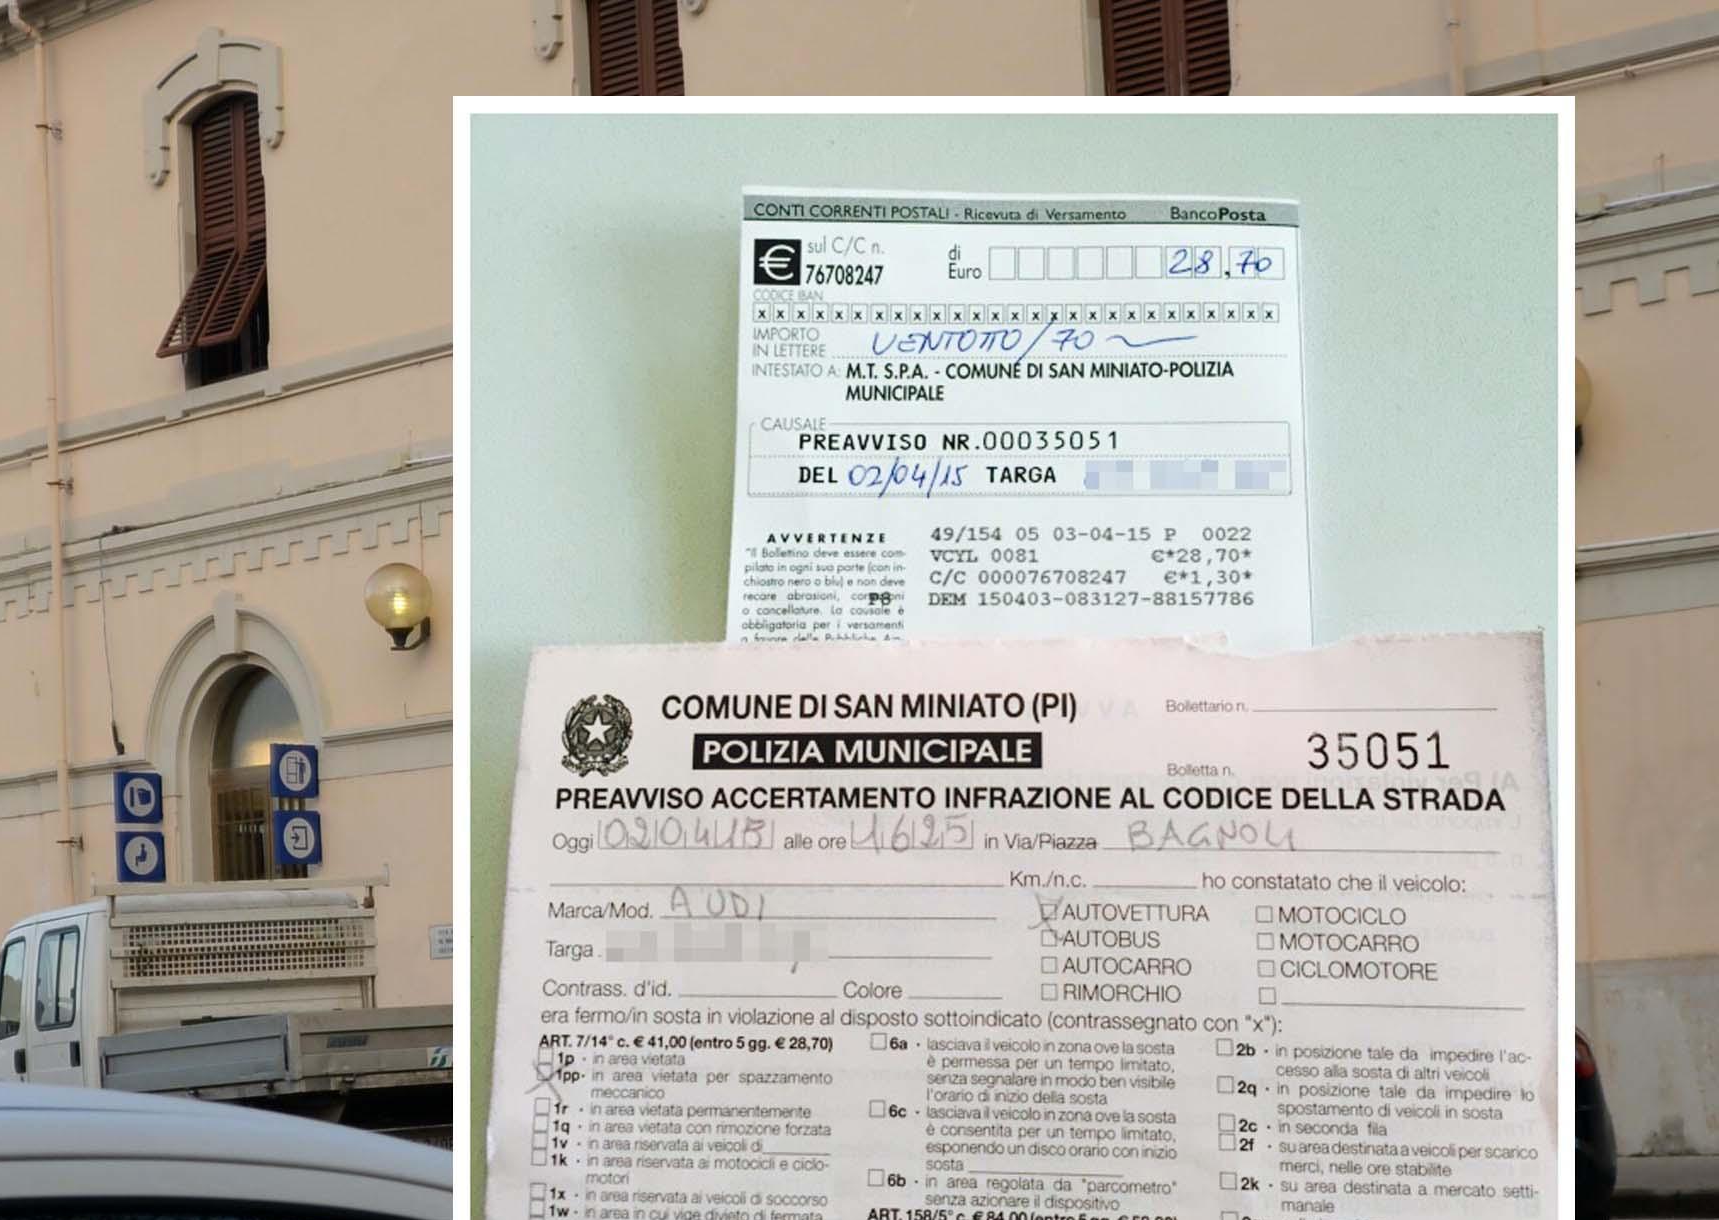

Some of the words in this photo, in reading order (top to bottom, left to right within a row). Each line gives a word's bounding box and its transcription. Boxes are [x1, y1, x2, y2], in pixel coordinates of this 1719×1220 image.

[754, 204, 804, 217] CONTI
[810, 204, 886, 218] CORRENTI
[892, 206, 949, 219] POSTALI
[964, 208, 1022, 220] Ricevuta
[1026, 209, 1038, 220] di
[1047, 208, 1127, 221] Versamento
[1170, 207, 1266, 222] BancoPosta
[808, 235, 826, 254] sul
[832, 236, 865, 256] C/C
[871, 242, 884, 254] n.
[948, 244, 960, 260] di
[806, 264, 883, 285] 76708247
[949, 263, 982, 279] Euro
[753, 290, 794, 300] CODICE
[798, 290, 823, 300] IBAN
[753, 327, 824, 341] IMPORTO
[753, 343, 767, 356] IN
[774, 343, 826, 358] LETTERE
[752, 363, 823, 378] INTESTATO
[846, 363, 877, 379] M.T.
[884, 363, 928, 379] S.P.A.
[946, 362, 1021, 378] COMUNE
[1027, 363, 1042, 378] DI
[1049, 363, 1084, 378] SAN
[1090, 361, 1234, 378] MINIATO-POLIZIA
[846, 385, 944, 401] MUNICIPALE
[761, 418, 826, 431] CAUSALE
[800, 434, 926, 450] PREAVVISO
[943, 431, 1116, 450] NR.00035051
[799, 467, 838, 483] DEL
[986, 467, 1056, 483] TARGA
[767, 533, 884, 543] AVVERTENZE
[931, 527, 1001, 543] 49/154
[1016, 527, 1039, 541] 05
[1053, 527, 1151, 541] 03-04-15
[1164, 528, 1176, 541] P
[1202, 527, 1251, 541] 0022
[930, 550, 978, 563] VCYL
[991, 548, 1038, 563] 0081
[930, 569, 966, 586] C/C
[978, 570, 1126, 584] 000076708247
[929, 593, 966, 606] DEM
[662, 695, 792, 719] COMUNE
[800, 694, 826, 718] DI
[834, 694, 892, 719] SAN
[902, 693, 1025, 718] MINIATO
[1033, 693, 1076, 723] (PI)
[1166, 699, 1233, 712] Bollettario
[702, 740, 821, 765] POLIZIA
[835, 739, 1032, 764] MUNICIPALE
[1308, 732, 1449, 770] 35051
[1167, 763, 1218, 776] Bolletta
[1223, 766, 1234, 776] n.
[556, 788, 703, 809] PREAVVISO
[711, 787, 935, 809] ACCERTAMENTO
[944, 786, 1111, 810] INFRAZIONE
[1120, 788, 1154, 810] AL
[1163, 787, 1272, 810] CODICE
[1282, 788, 1374, 809] DELLA
[1384, 788, 1505, 811] STRADA
[553, 833, 593, 854] Oggi
[784, 834, 813, 850] alle
[818, 836, 846, 850] ore
[985, 834, 998, 849] in
[1007, 832, 1098, 852] Via/Piazza
[1010, 871, 1087, 888] Km./n.c.
[1202, 872, 1226, 889] ho
[1232, 875, 1331, 890] constatato
[1338, 874, 1372, 891] che
[1379, 874, 1387, 891] il
[1393, 875, 1465, 892] veicolo:
[549, 902, 653, 918] Marca/Mod.
[1063, 904, 1209, 923] AUTOVETTURA
[1279, 906, 1406, 925] MOTOCICLO
[1063, 930, 1160, 949] AUTOBUS
[1280, 933, 1419, 953] MOTOCARRO
[546, 940, 593, 961] Targa
[1063, 957, 1192, 976] AUTOCARRO
[1281, 960, 1438, 981] CICLOMOTORE
[543, 979, 626, 997] Contrass.
[634, 980, 671, 997] d'id.
[843, 981, 902, 999] Colore
[1064, 983, 1181, 1003] RIMORCHIO
[541, 1010, 568, 1024] era
[575, 1007, 647, 1024] fermo/in
[653, 1009, 701, 1024] sosta
[708, 1011, 722, 1024] in
[728, 1008, 814, 1025] violazione
[820, 1009, 834, 1025] al
[840, 1009, 918, 1029] disposto
[924, 1012, 1043, 1029] sottoindicato
[1048, 1013, 1197, 1034] (contrassegnato
[1203, 1017, 1238, 1032] con
[539, 1035, 571, 1048] ART.
[617, 1038, 629, 1048] c.
[633, 1036, 644, 1047] €
[648, 1036, 687, 1050] 41,00
[690, 1036, 733, 1051] (entro
[736, 1036, 745, 1049] 5
[748, 1040, 770, 1052] gg.
[775, 1037, 785, 1049] €
[789, 1037, 833, 1052] 28,70)
[558, 1054, 574, 1066] 1p
[593, 1055, 604, 1064] in
[608, 1055, 637, 1066] area
[642, 1054, 685, 1066] vietata
[592, 1069, 604, 1081] in
[613, 1072, 642, 1082] area
[652, 1070, 697, 1083] vietata
[706, 1072, 729, 1085] per
[739, 1073, 833, 1085] spazzamento
[591, 1087, 665, 1099] meccanico
[1239, 1119, 1257, 1132] 2c
[1278, 1120, 1291, 1133] in
[1295, 1123, 1358, 1135] seconda
[1367, 1121, 1387, 1136] fila
